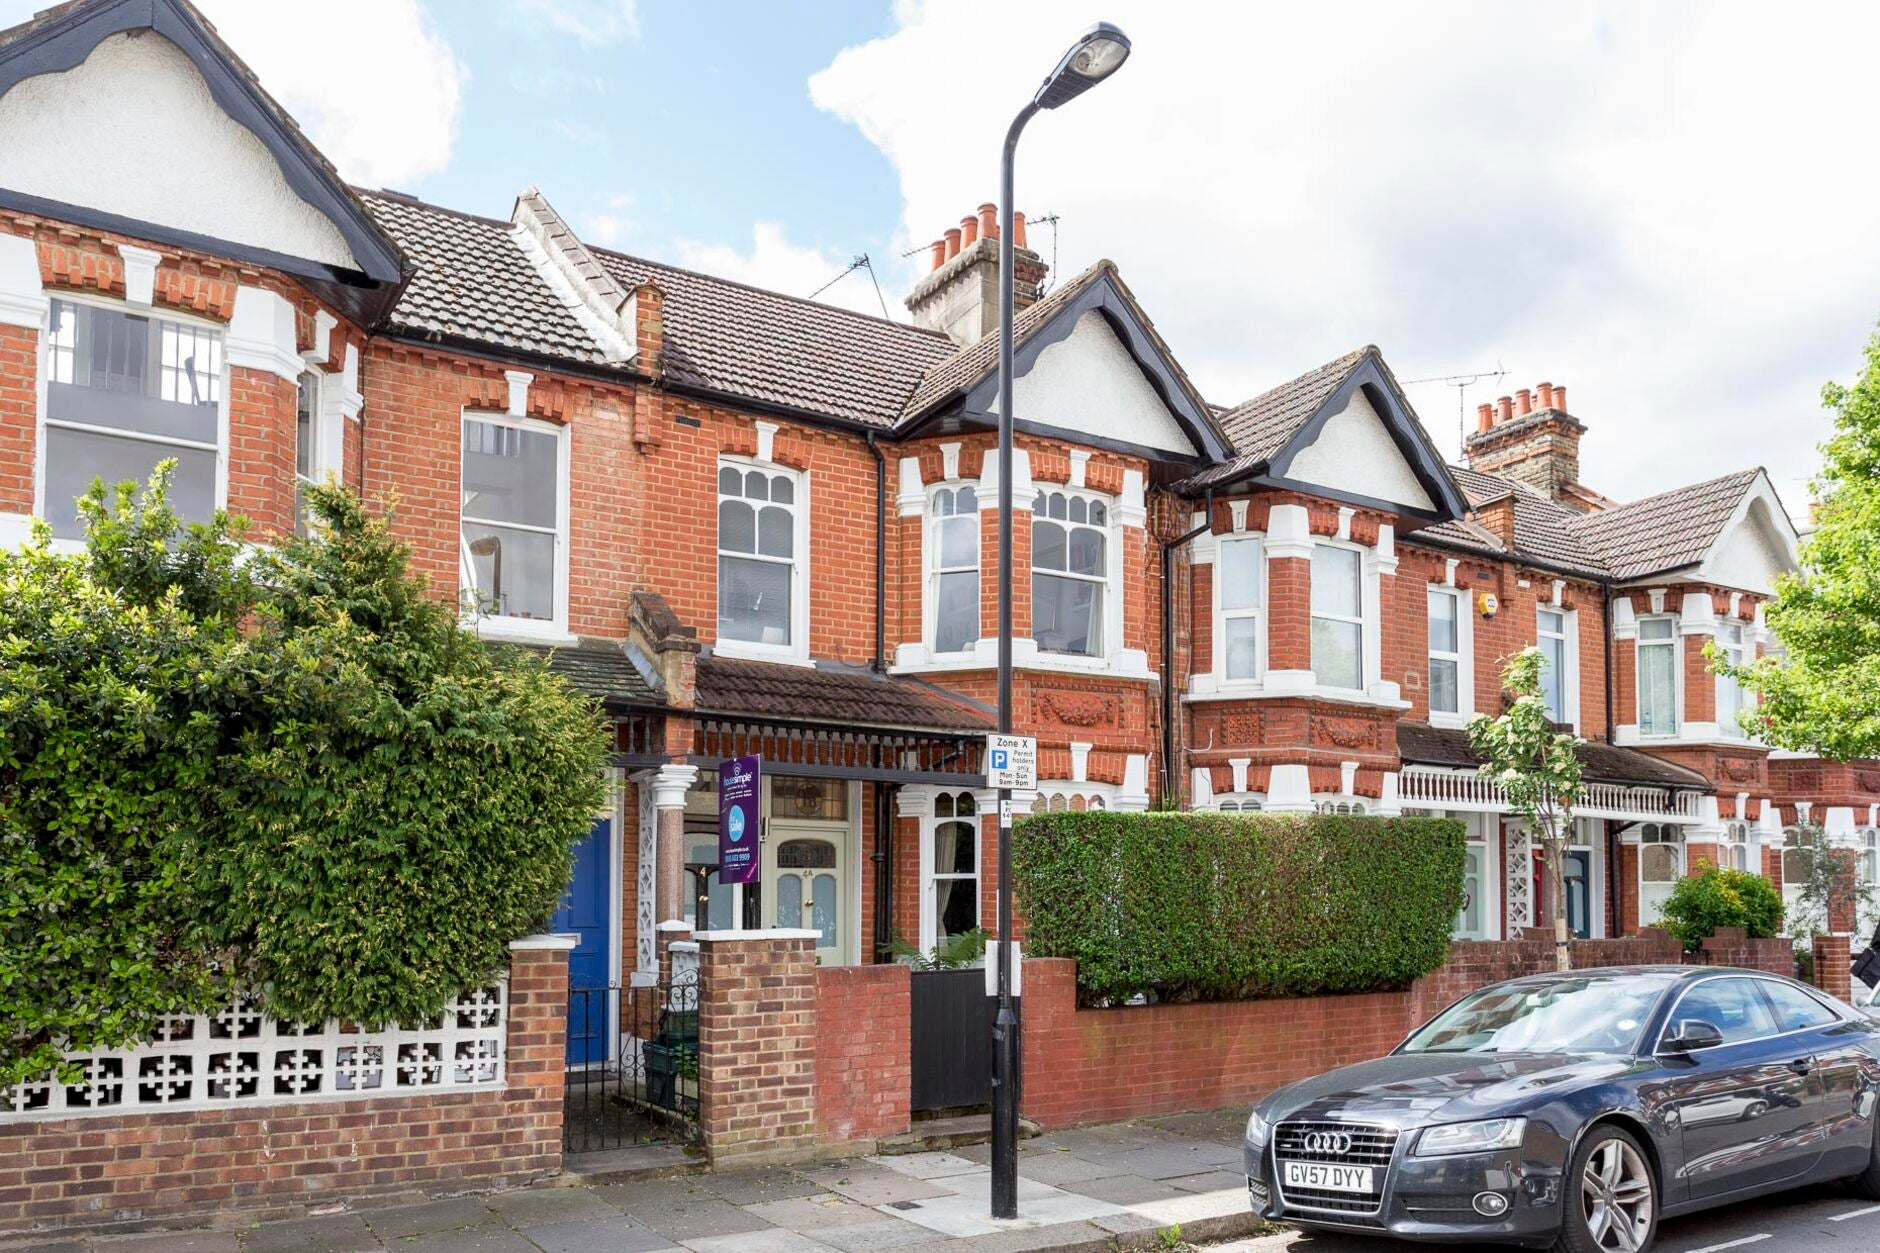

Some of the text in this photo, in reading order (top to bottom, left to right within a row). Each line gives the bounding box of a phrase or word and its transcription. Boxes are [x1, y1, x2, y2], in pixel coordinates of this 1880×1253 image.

[997, 738, 1028, 748] Zone X
[995, 753, 1005, 767] P
[700, 867, 706, 877] 4
[802, 870, 813, 878] 4A
[1291, 1165, 1364, 1188] GV57 DYY
